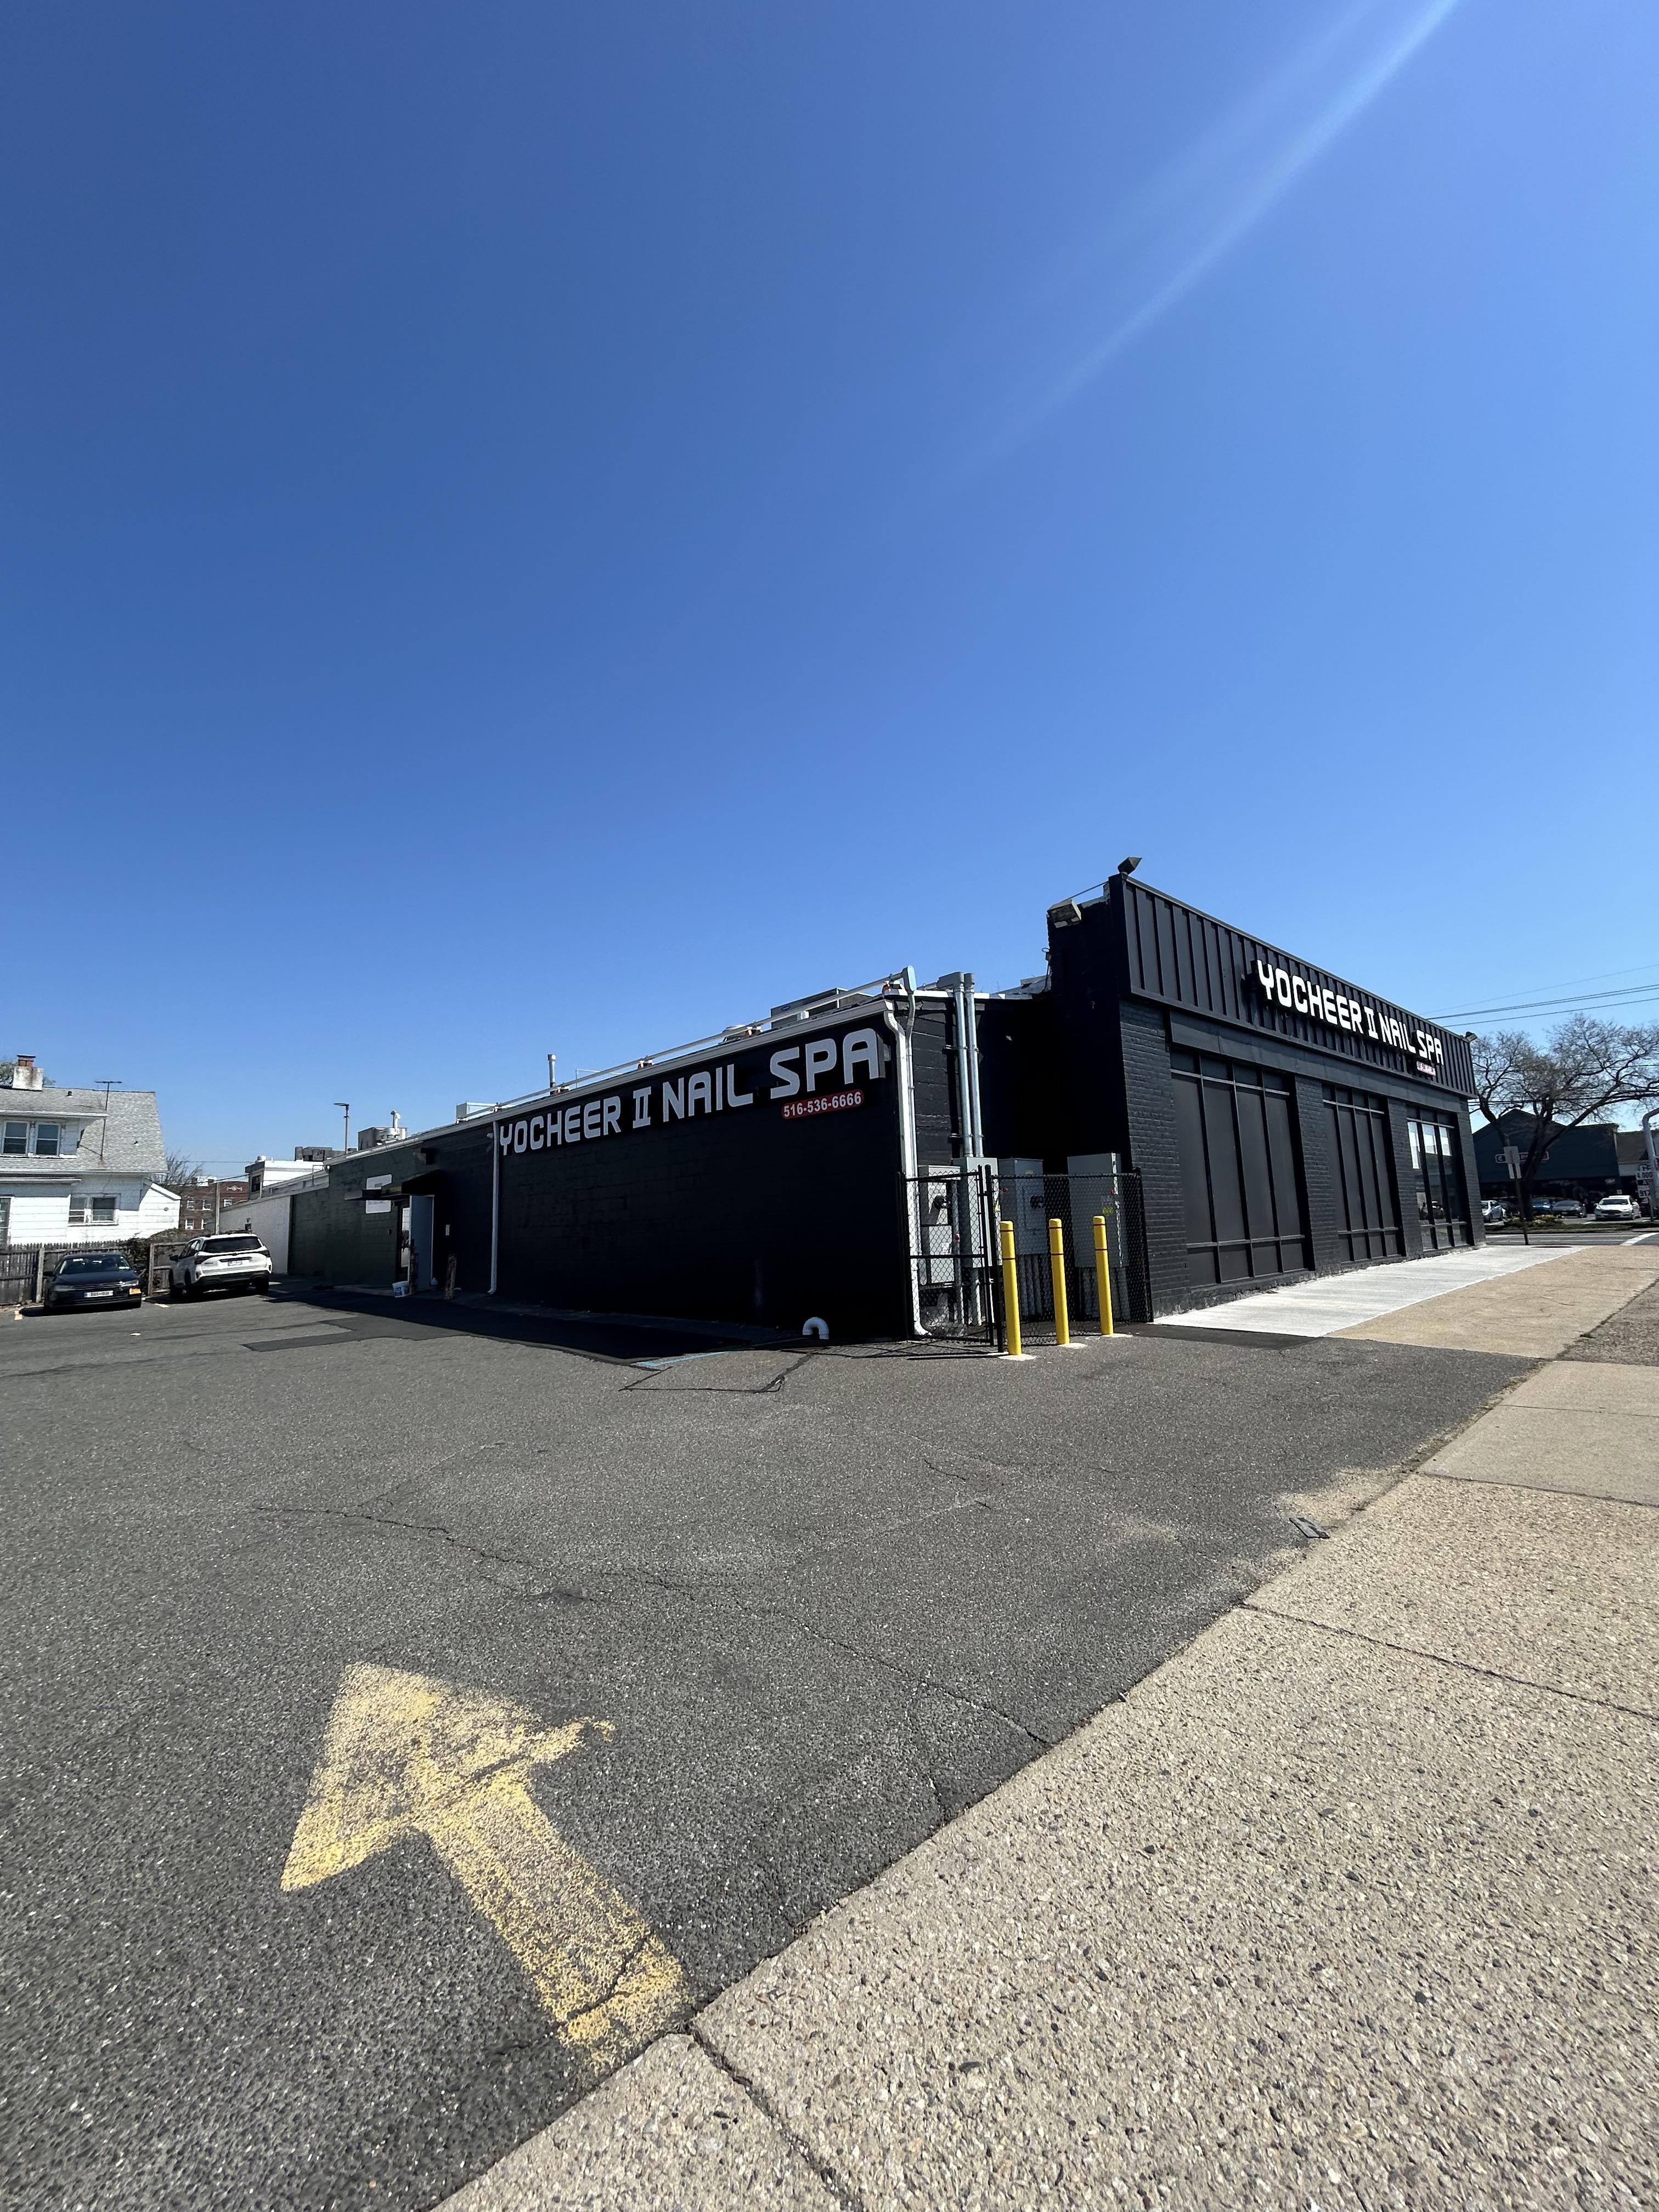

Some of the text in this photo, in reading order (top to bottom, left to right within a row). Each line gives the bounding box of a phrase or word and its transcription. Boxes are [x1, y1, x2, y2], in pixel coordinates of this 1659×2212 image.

[1257, 959, 1444, 1066] YOCHEER II NAIL SPA
[500, 1028, 880, 1156] YOCHEER II NAIL SPA
[783, 1091, 862, 1118] 516-536-6666
